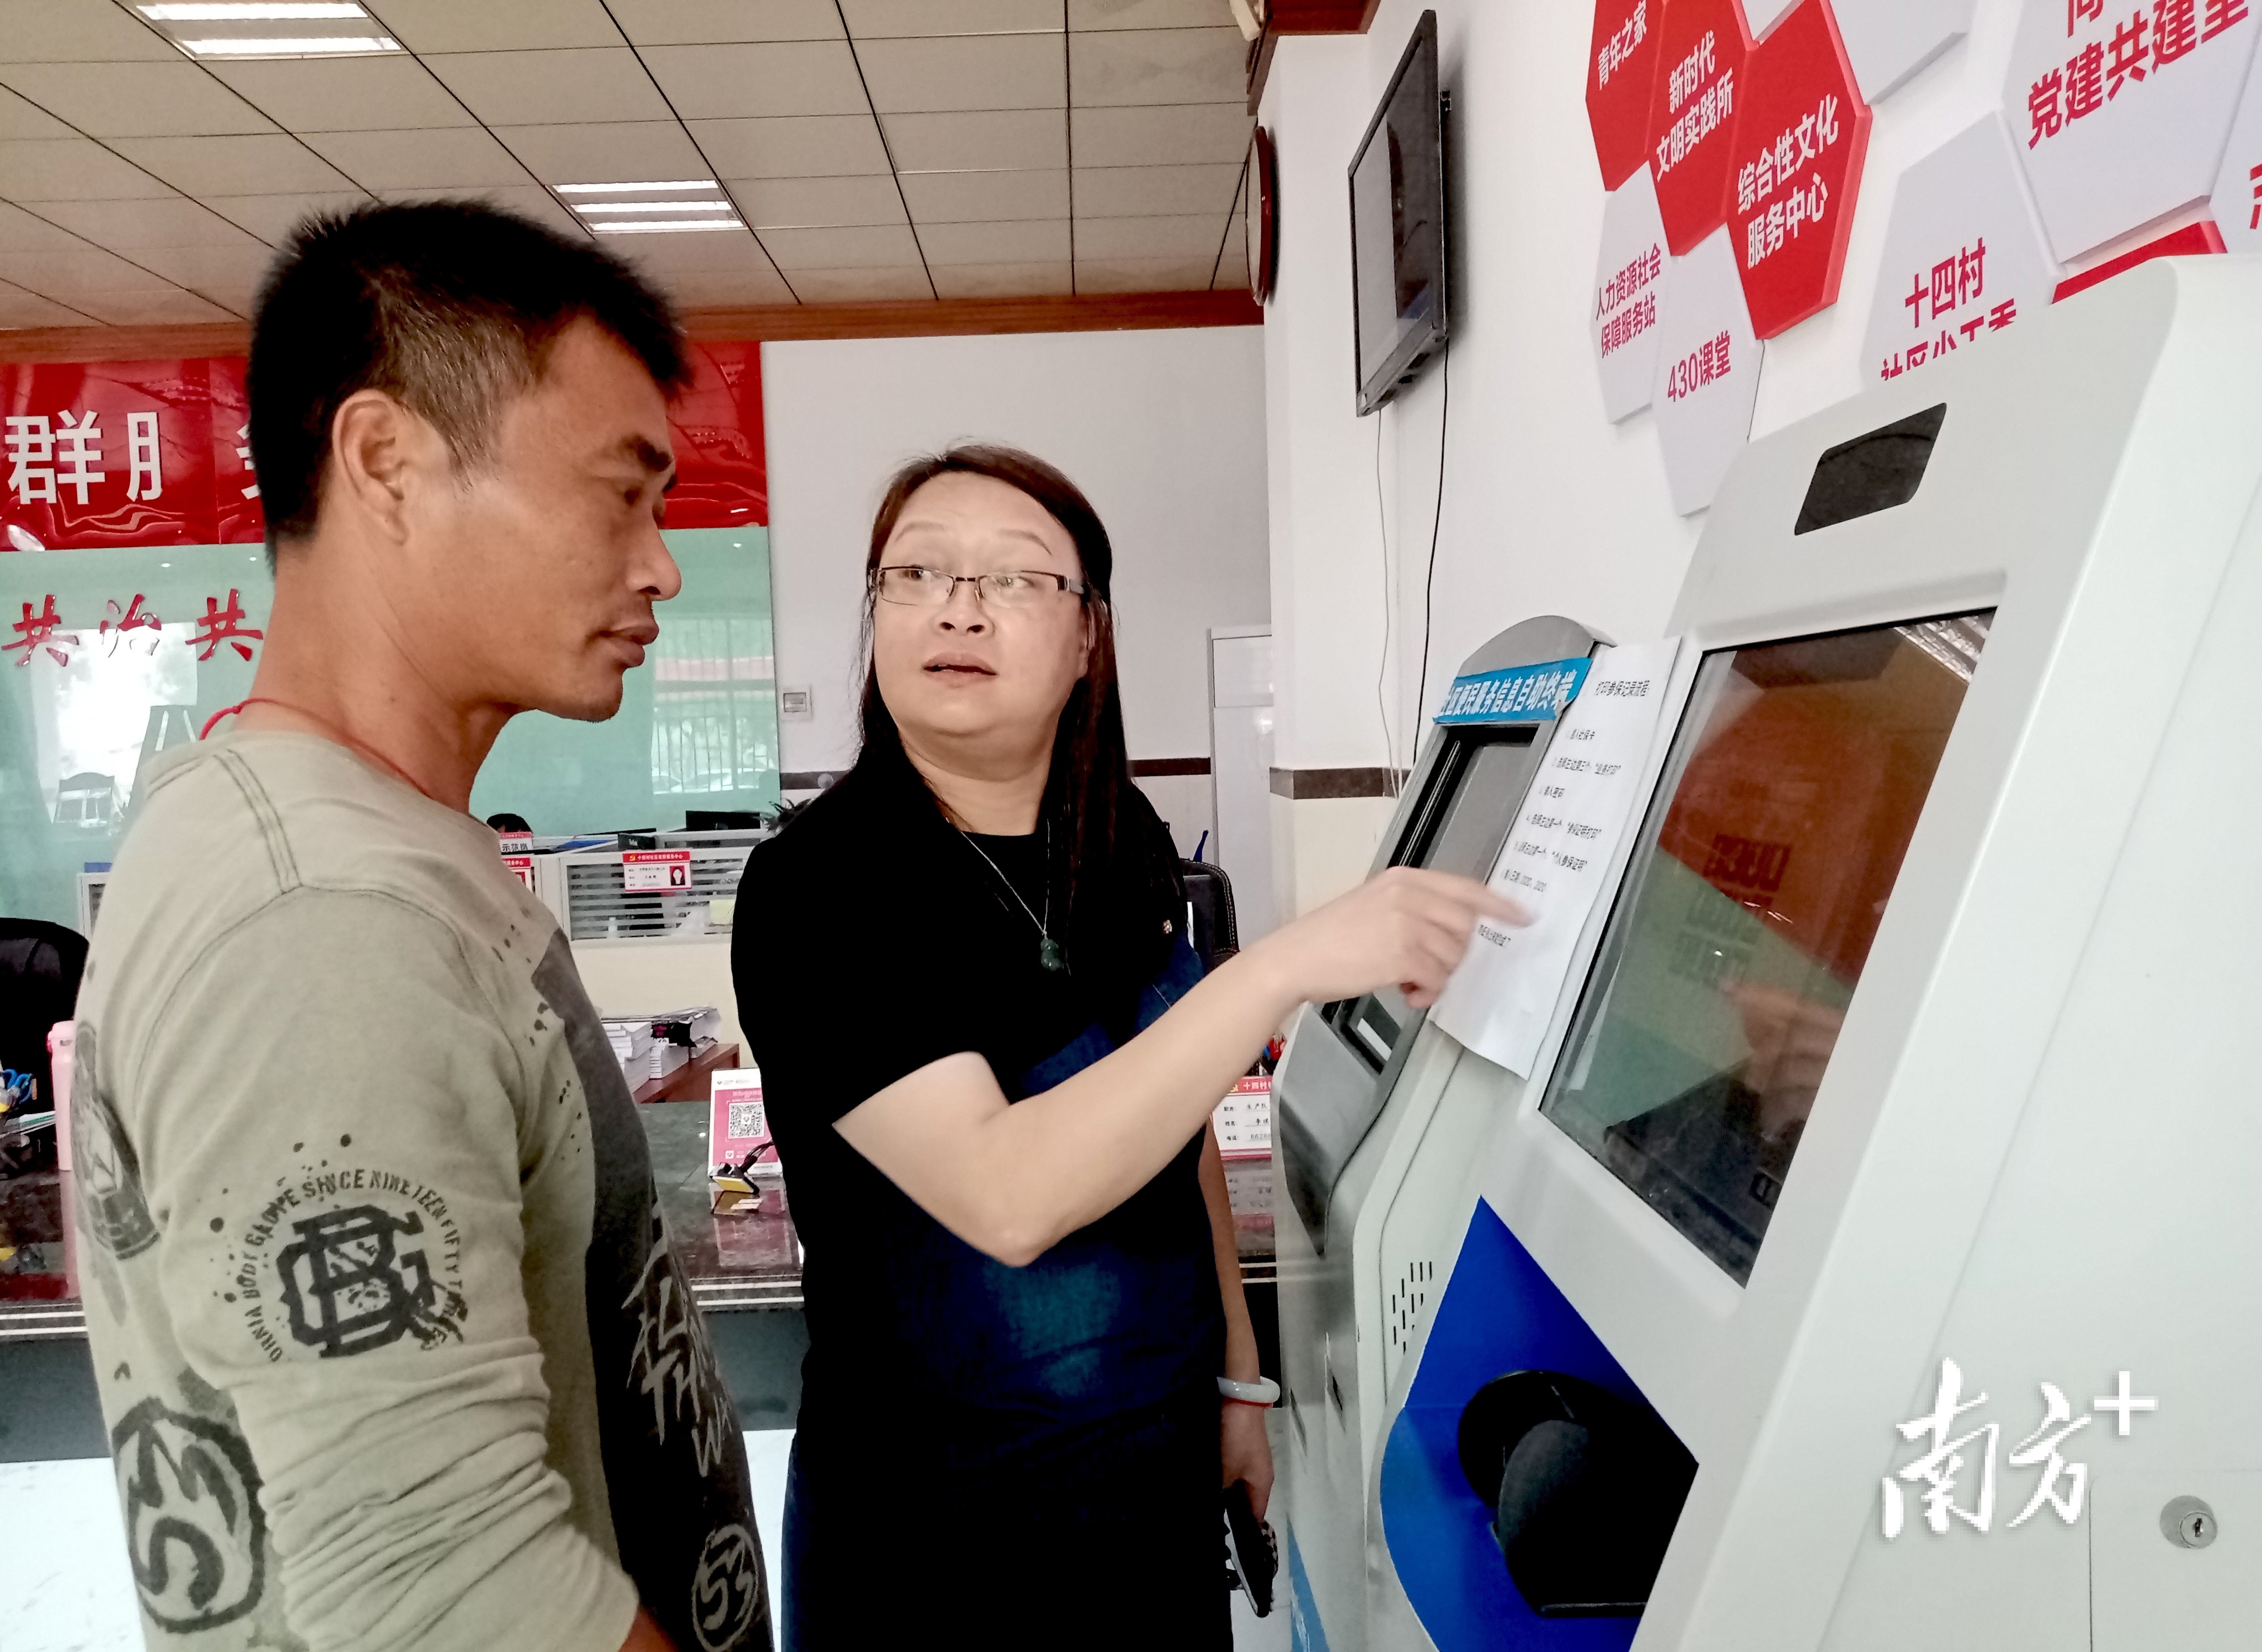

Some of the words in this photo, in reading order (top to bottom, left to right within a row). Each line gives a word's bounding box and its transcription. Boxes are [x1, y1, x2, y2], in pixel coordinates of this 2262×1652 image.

[1598, 1, 1647, 90] 青年之家
[1669, 30, 1716, 114] 新时代
[1656, 68, 1734, 182] 文明实践所
[1738, 93, 1838, 215] 综合性文化
[1747, 172, 1828, 270] 服务中心
[1596, 243, 1661, 322] 人力资源社会
[1602, 291, 1655, 359] 保障服务站
[1905, 237, 1986, 329] 十四村
[1667, 330, 1731, 402] 430课堂
